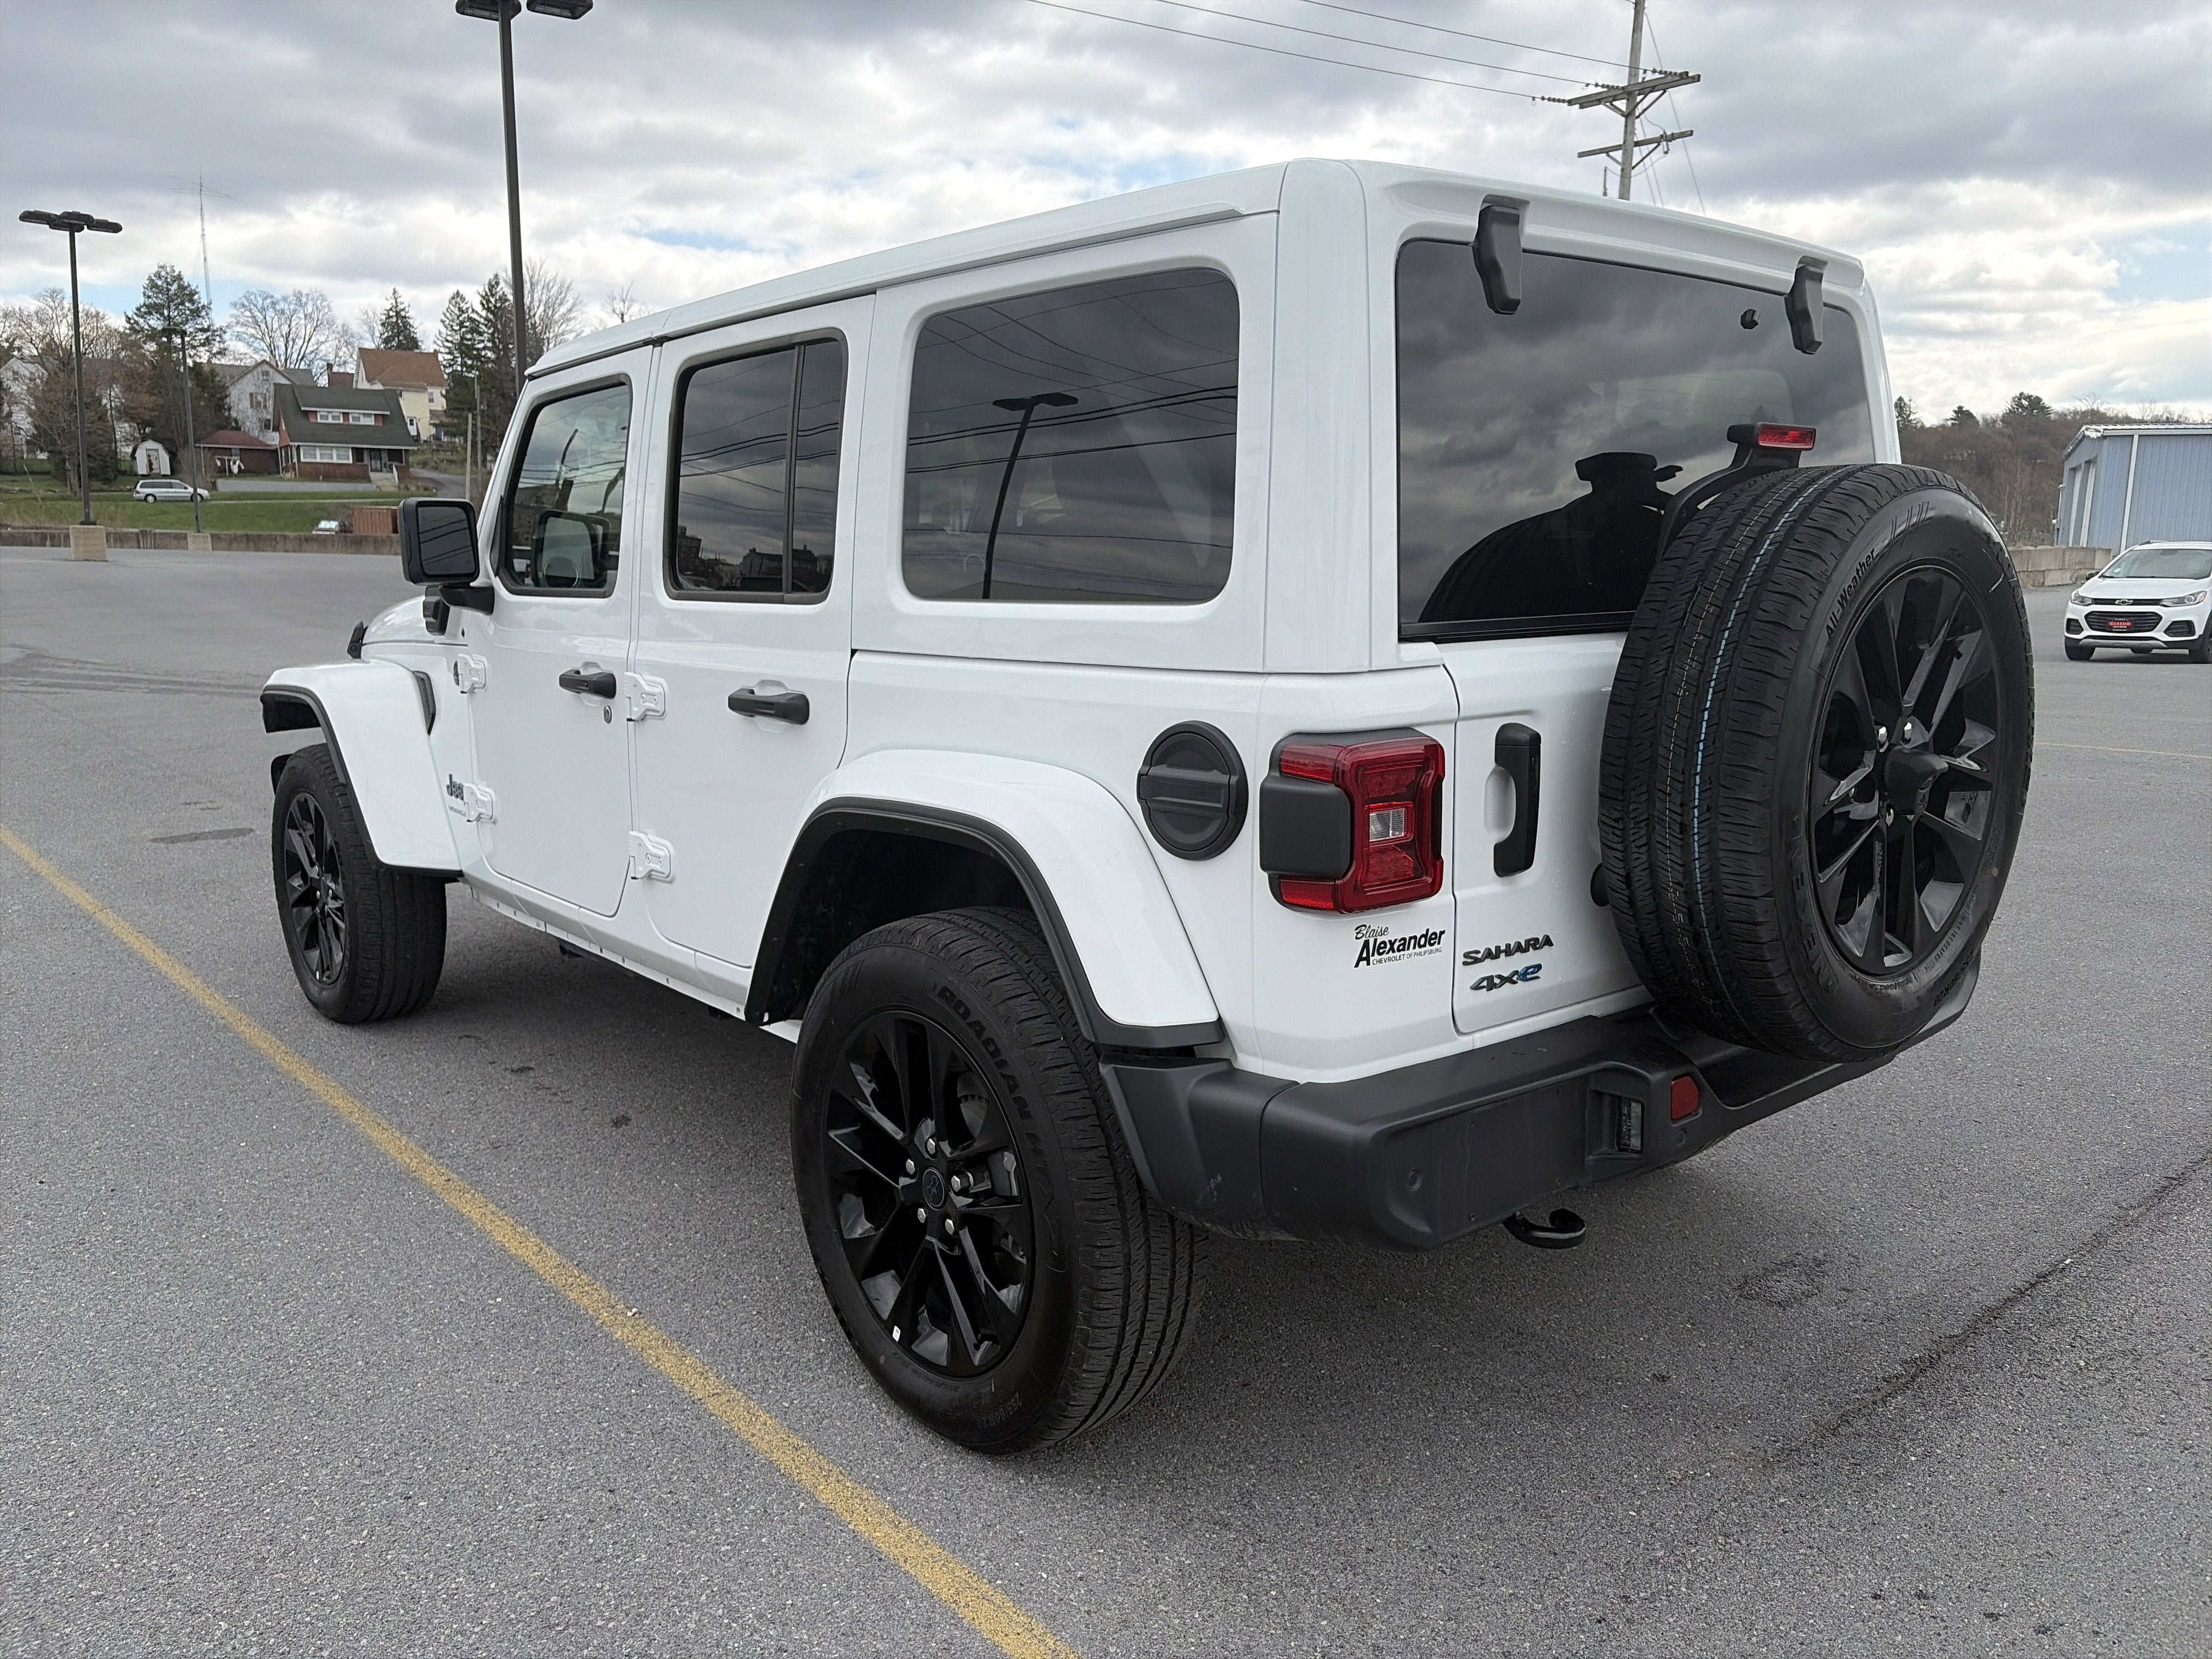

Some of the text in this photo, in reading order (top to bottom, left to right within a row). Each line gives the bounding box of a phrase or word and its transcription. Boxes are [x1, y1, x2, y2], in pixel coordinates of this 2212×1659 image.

[1826, 549, 1875, 640] All-Weather
[446, 774, 464, 800] Jee
[1354, 924, 1389, 940] Blaise
[1354, 928, 1446, 968] Alexander
[1372, 953, 1406, 966] CHEVROLET
[1462, 934, 1554, 966] SAHARA
[937, 986, 1032, 1120] ROADIAN
